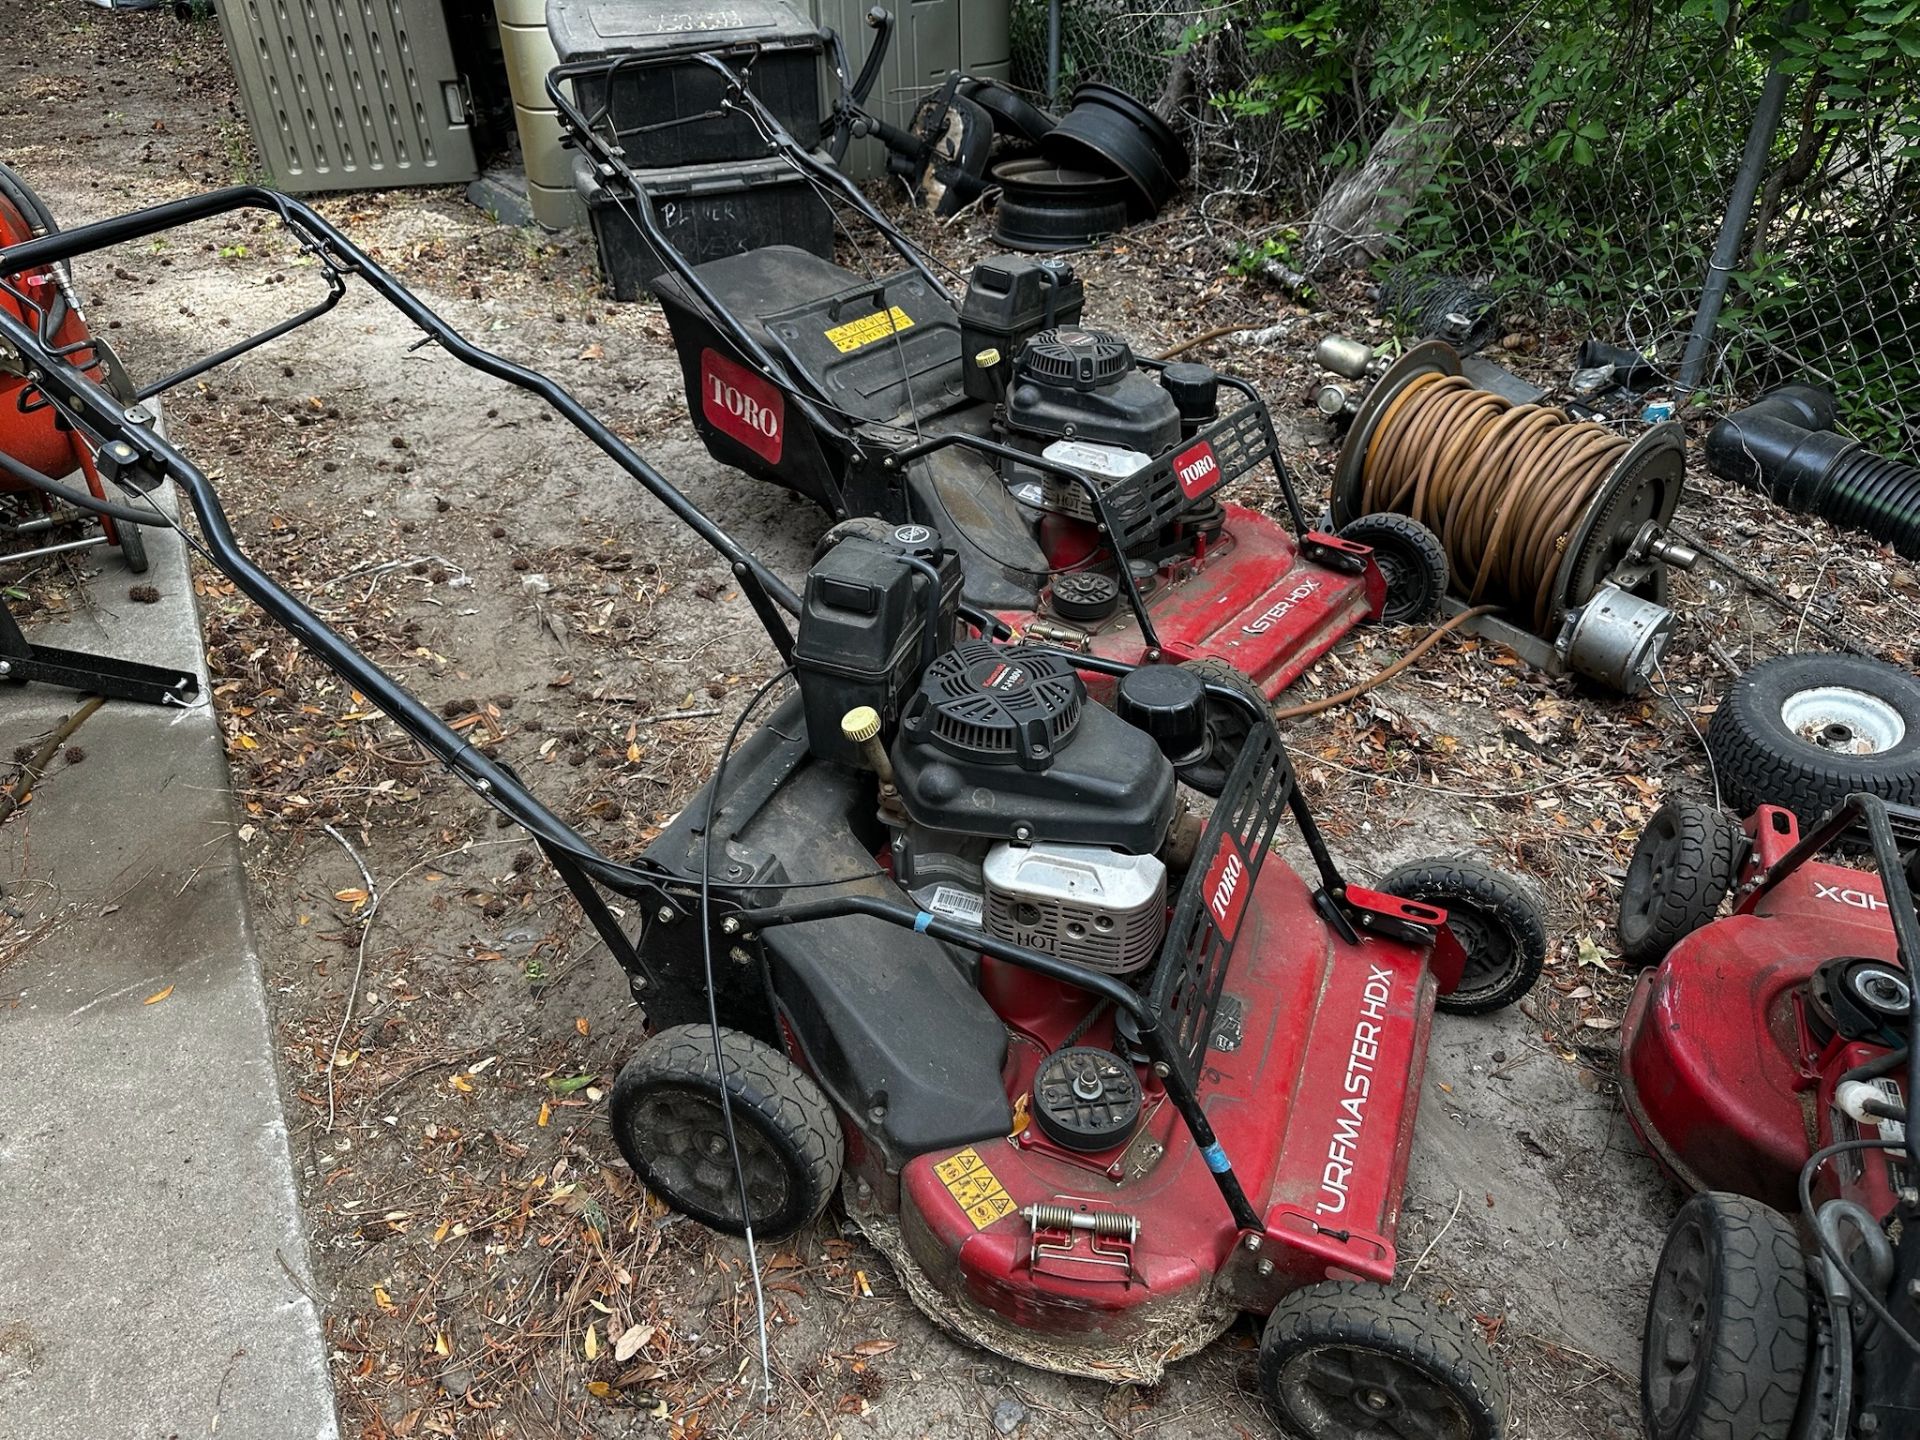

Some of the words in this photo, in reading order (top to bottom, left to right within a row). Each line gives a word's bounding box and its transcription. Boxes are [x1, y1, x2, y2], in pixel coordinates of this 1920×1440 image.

[708, 373, 778, 438] TORO
[1180, 455, 1215, 486] TORO
[1283, 579, 1320, 604] HDX
[1212, 854, 1241, 920] TORO
[1814, 881, 1889, 911] HDX
[1017, 931, 1059, 951] HOT
[1316, 1022, 1382, 1215] URFMASTER
[1360, 964, 1394, 1021] HDX
